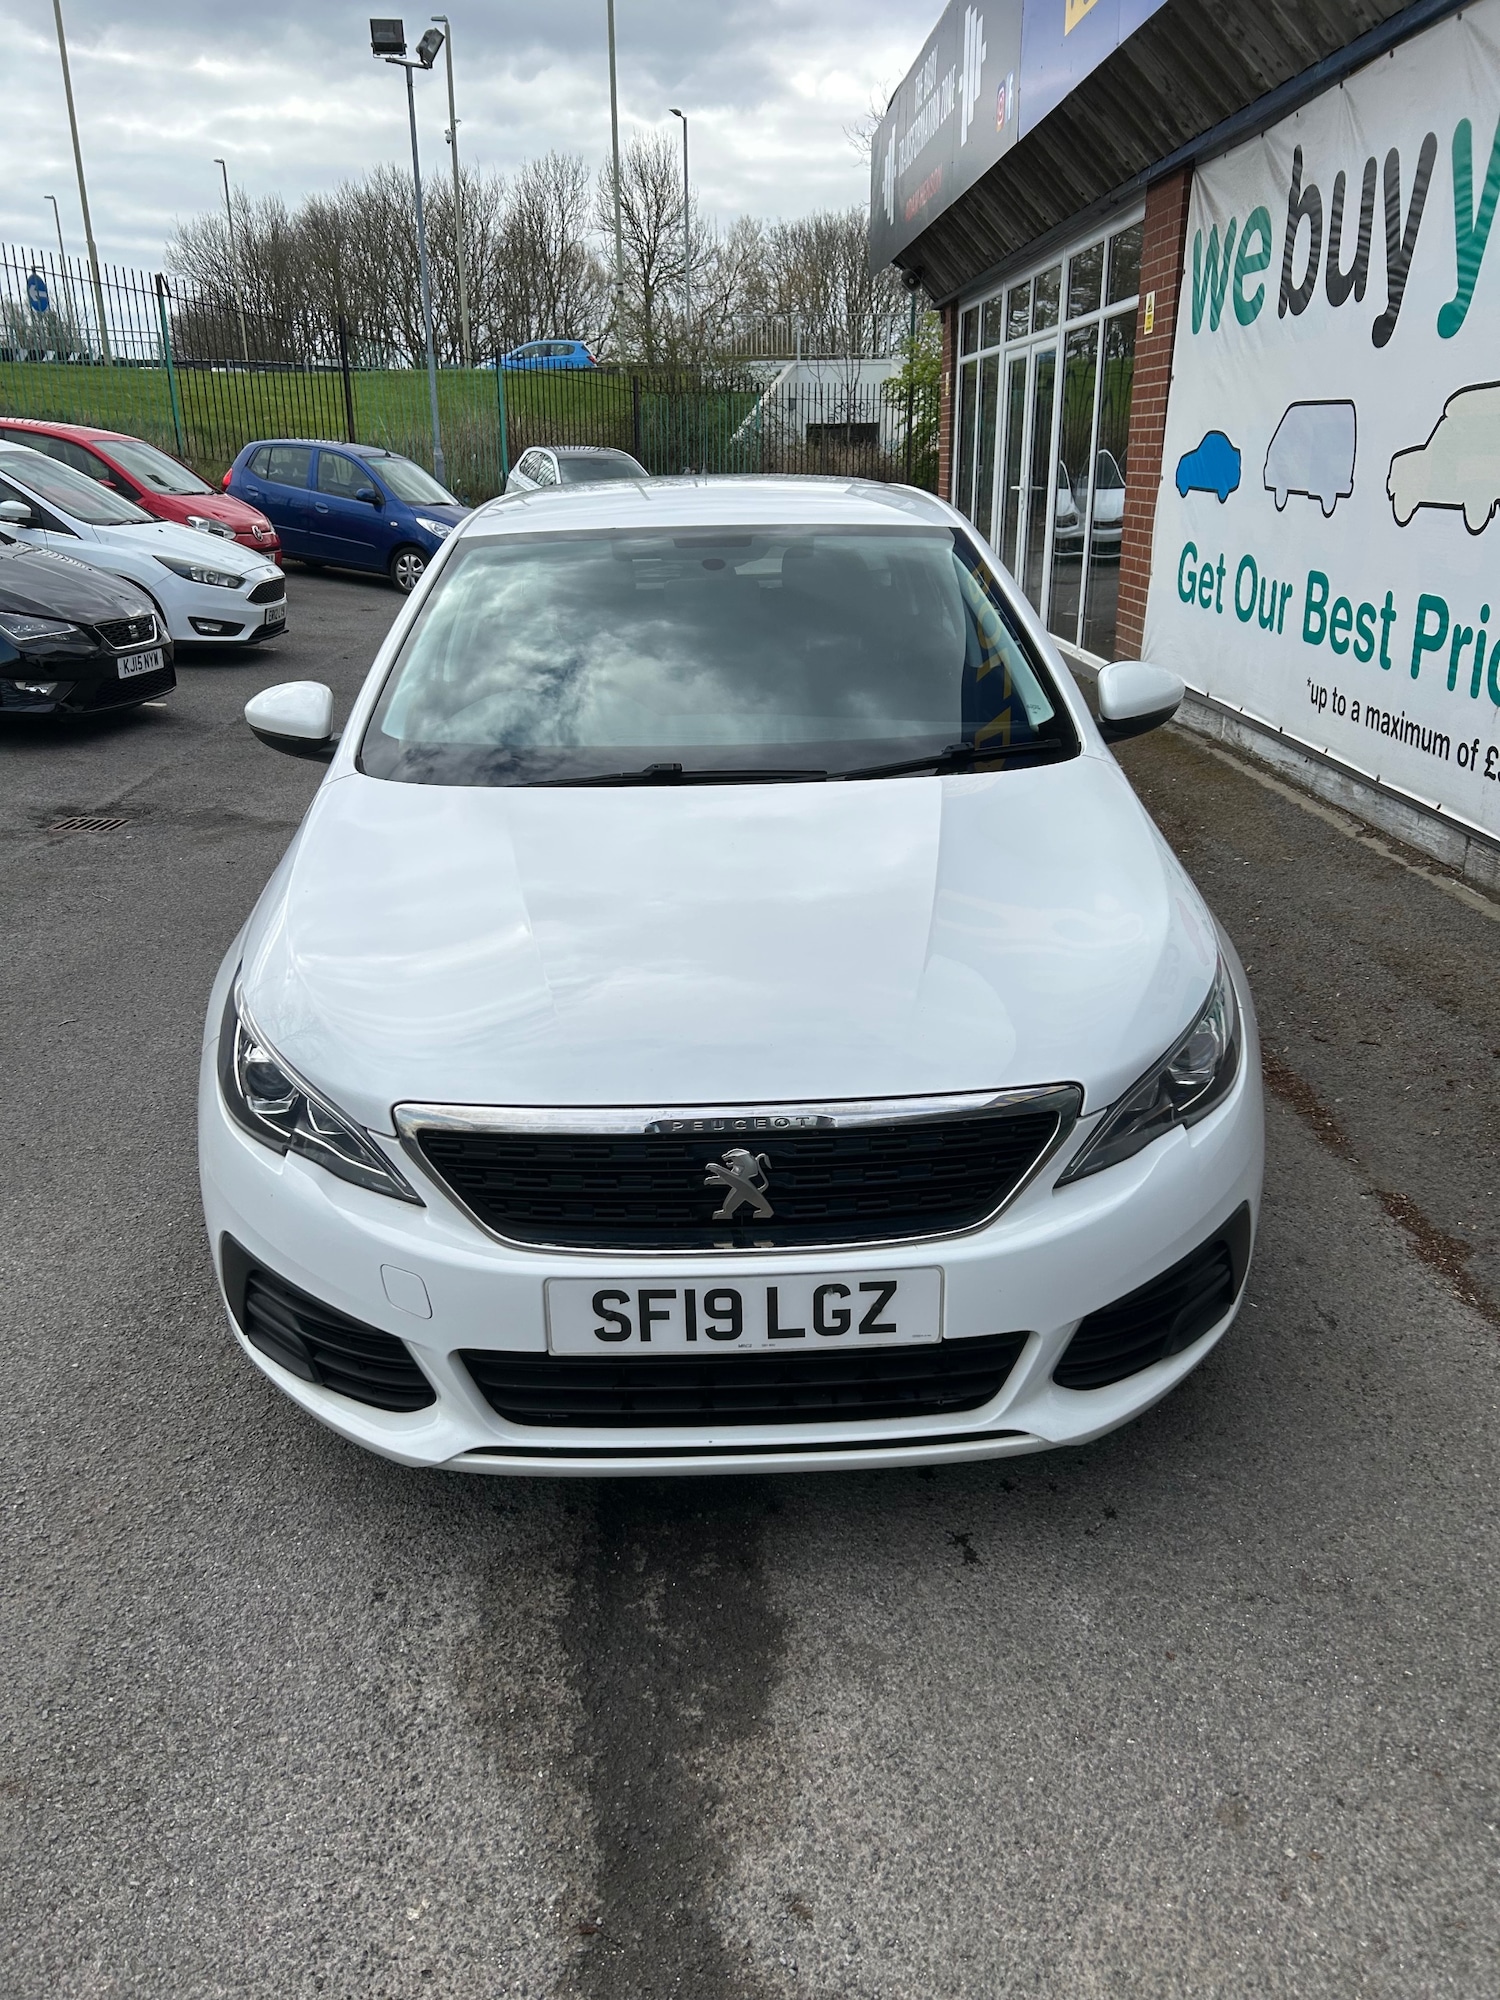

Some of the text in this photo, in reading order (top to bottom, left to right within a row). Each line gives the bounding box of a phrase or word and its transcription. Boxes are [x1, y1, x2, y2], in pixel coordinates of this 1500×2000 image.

[1177, 541, 1226, 614] Get
[1235, 553, 1293, 635] Our
[1302, 570, 1397, 670] Best
[123, 655, 143, 675] KJ15
[1332, 687, 1346, 716] to
[1351, 700, 1360, 723] a
[1365, 705, 1451, 760] maximum
[1457, 738, 1480, 771] of
[671, 1116, 810, 1132] PEUGEOT
[592, 1280, 898, 1342] SF19 LGZ
